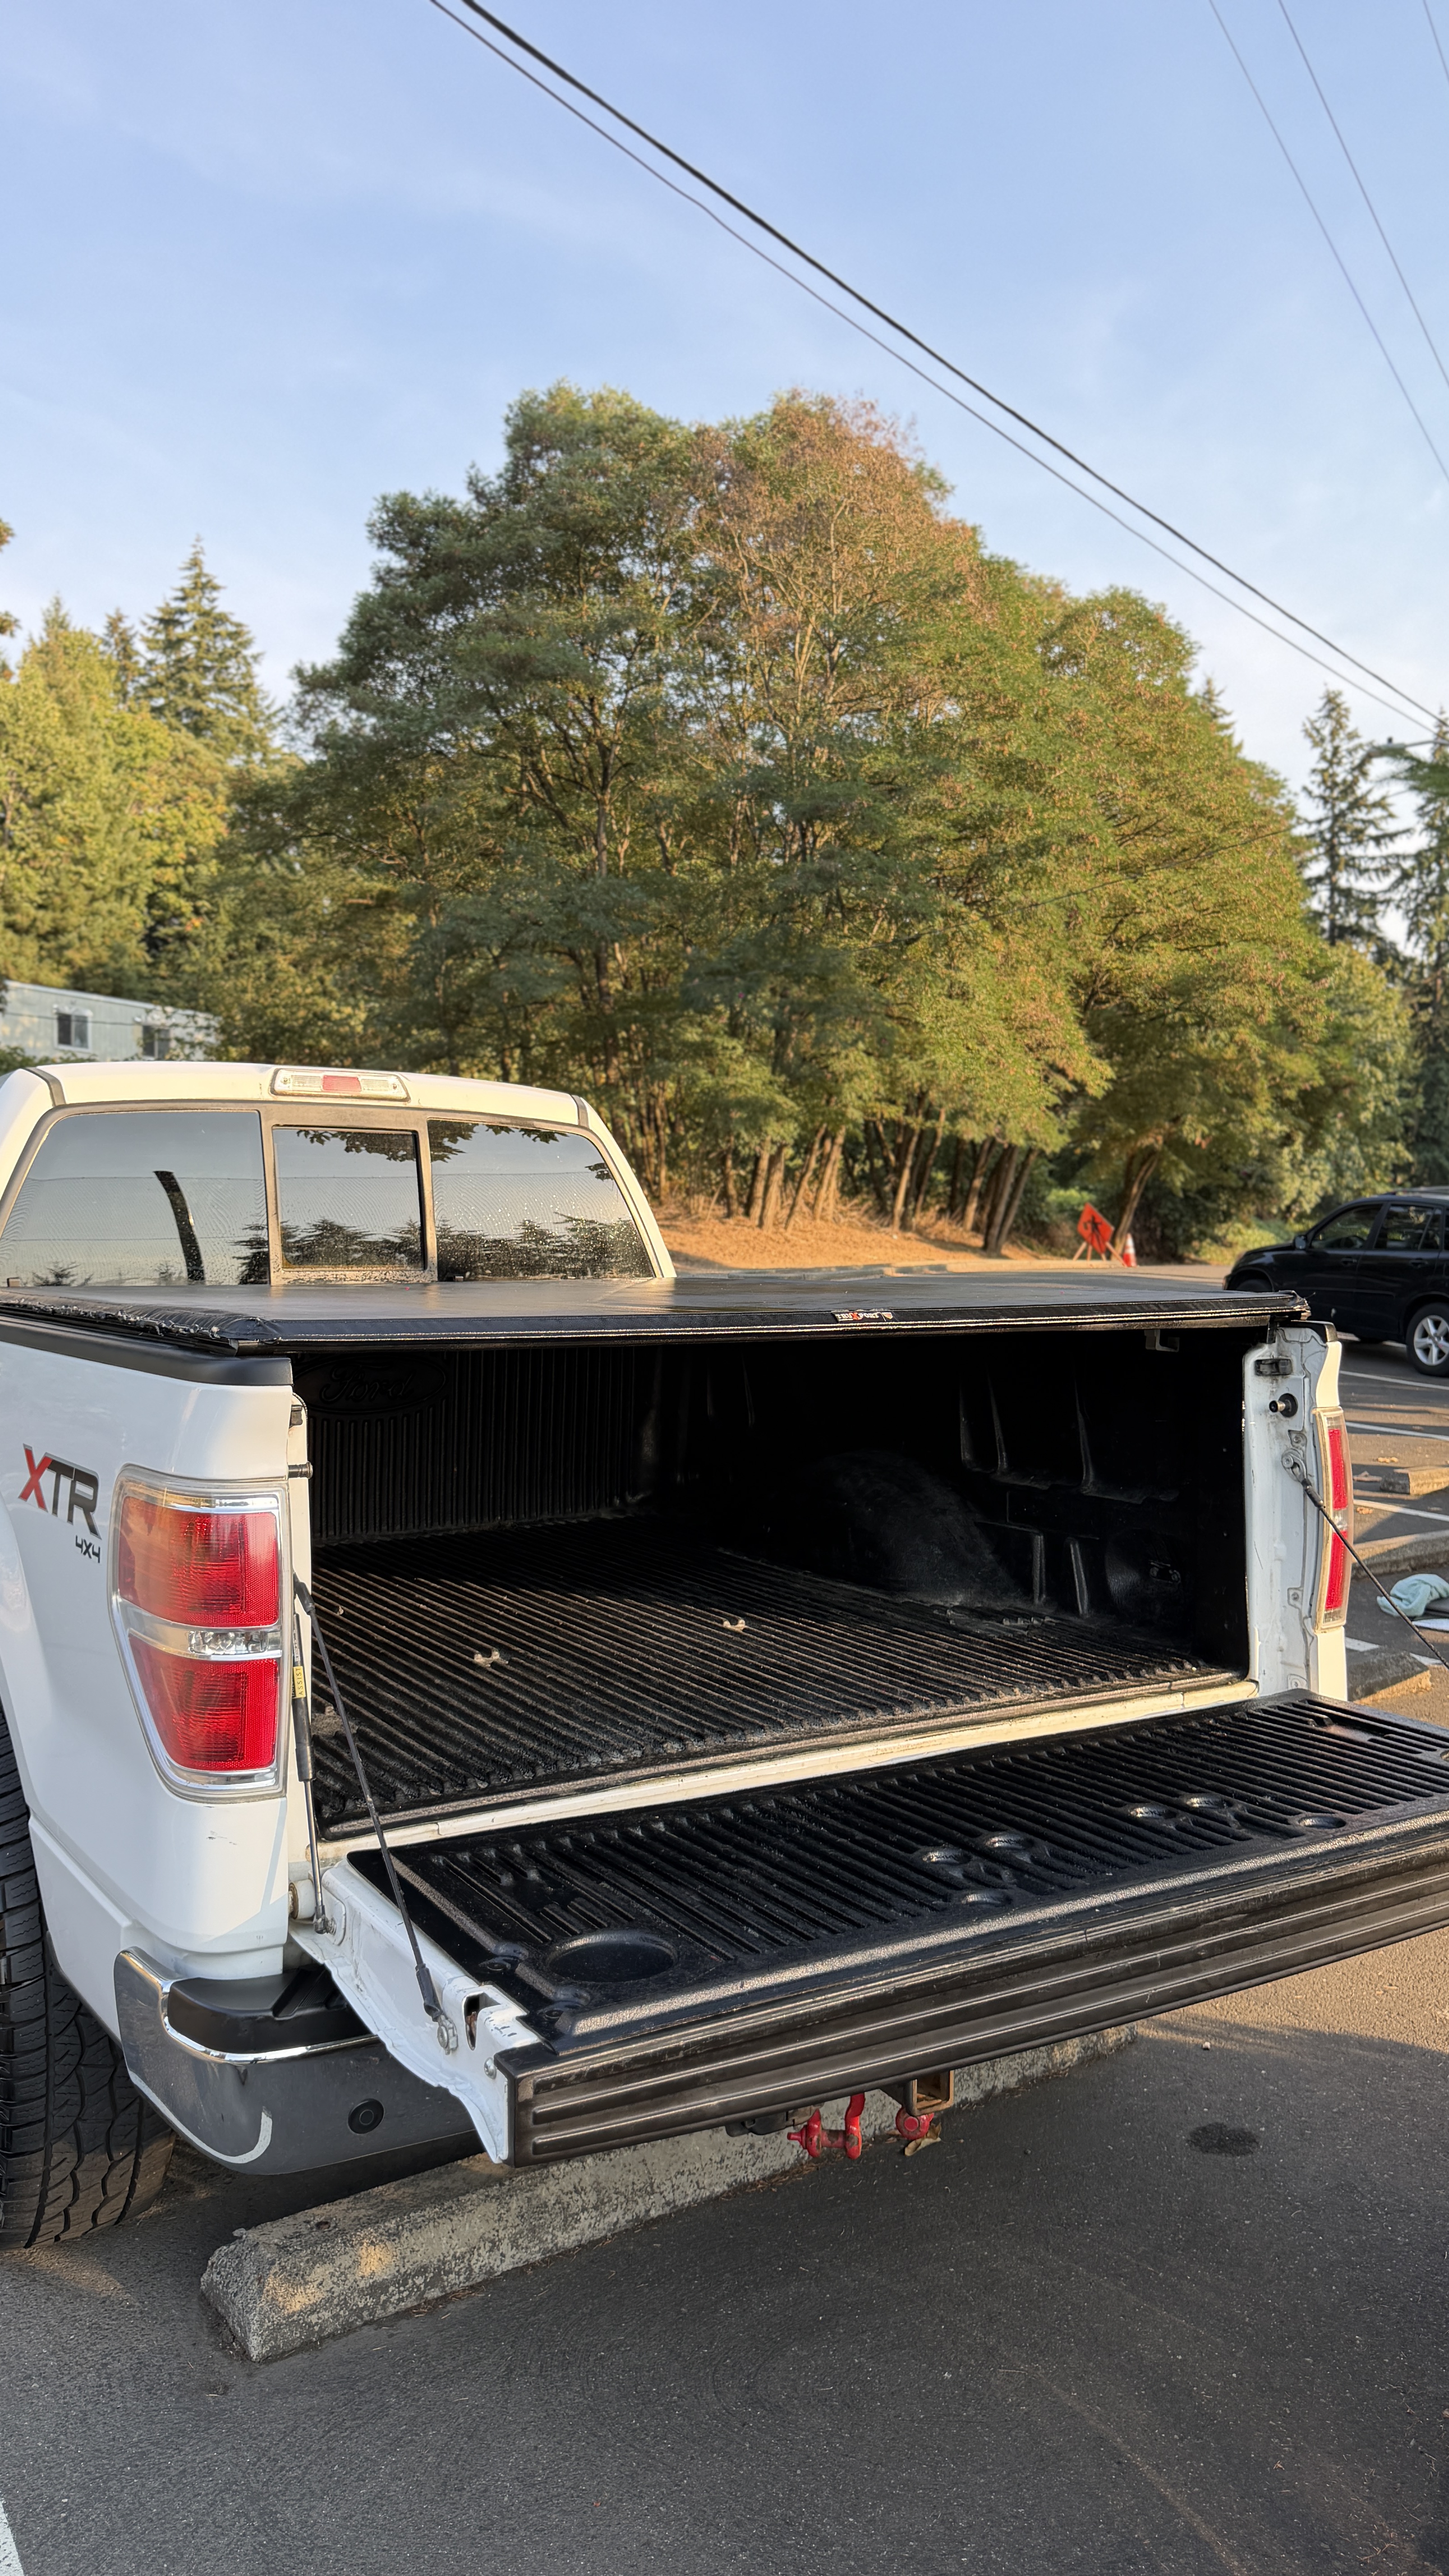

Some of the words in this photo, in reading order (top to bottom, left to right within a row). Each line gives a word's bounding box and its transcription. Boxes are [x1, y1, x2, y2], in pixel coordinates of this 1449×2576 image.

[320, 1362, 415, 1403] Ford
[18, 1443, 102, 1541] XTR
[295, 1668, 304, 1696] ASSIST
